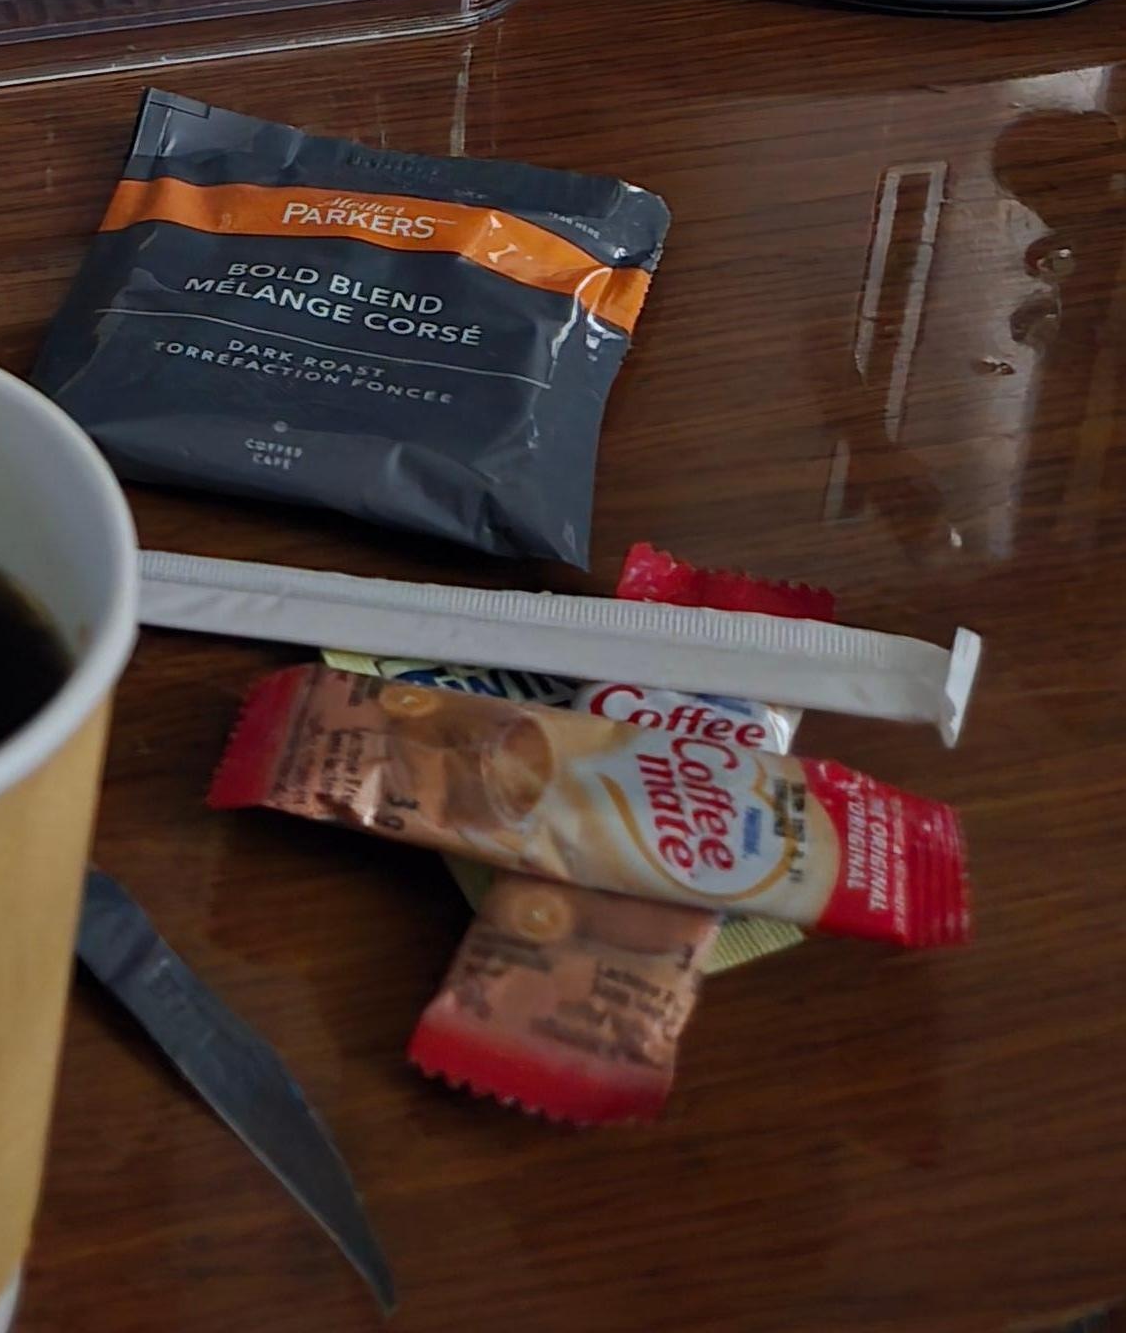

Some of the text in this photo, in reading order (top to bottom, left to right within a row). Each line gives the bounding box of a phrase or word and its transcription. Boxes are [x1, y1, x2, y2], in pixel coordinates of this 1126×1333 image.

[282, 202, 436, 240] PARKERS
[185, 275, 483, 347] MÉLANGE CORSÉ
[227, 261, 444, 315] BOLD BLEND
[228, 339, 386, 378] DARK ROAST
[589, 682, 767, 749] Coffee
[636, 753, 694, 871] mate
[671, 738, 740, 871] Coffee
[867, 821, 889, 913] ORIGINAL
